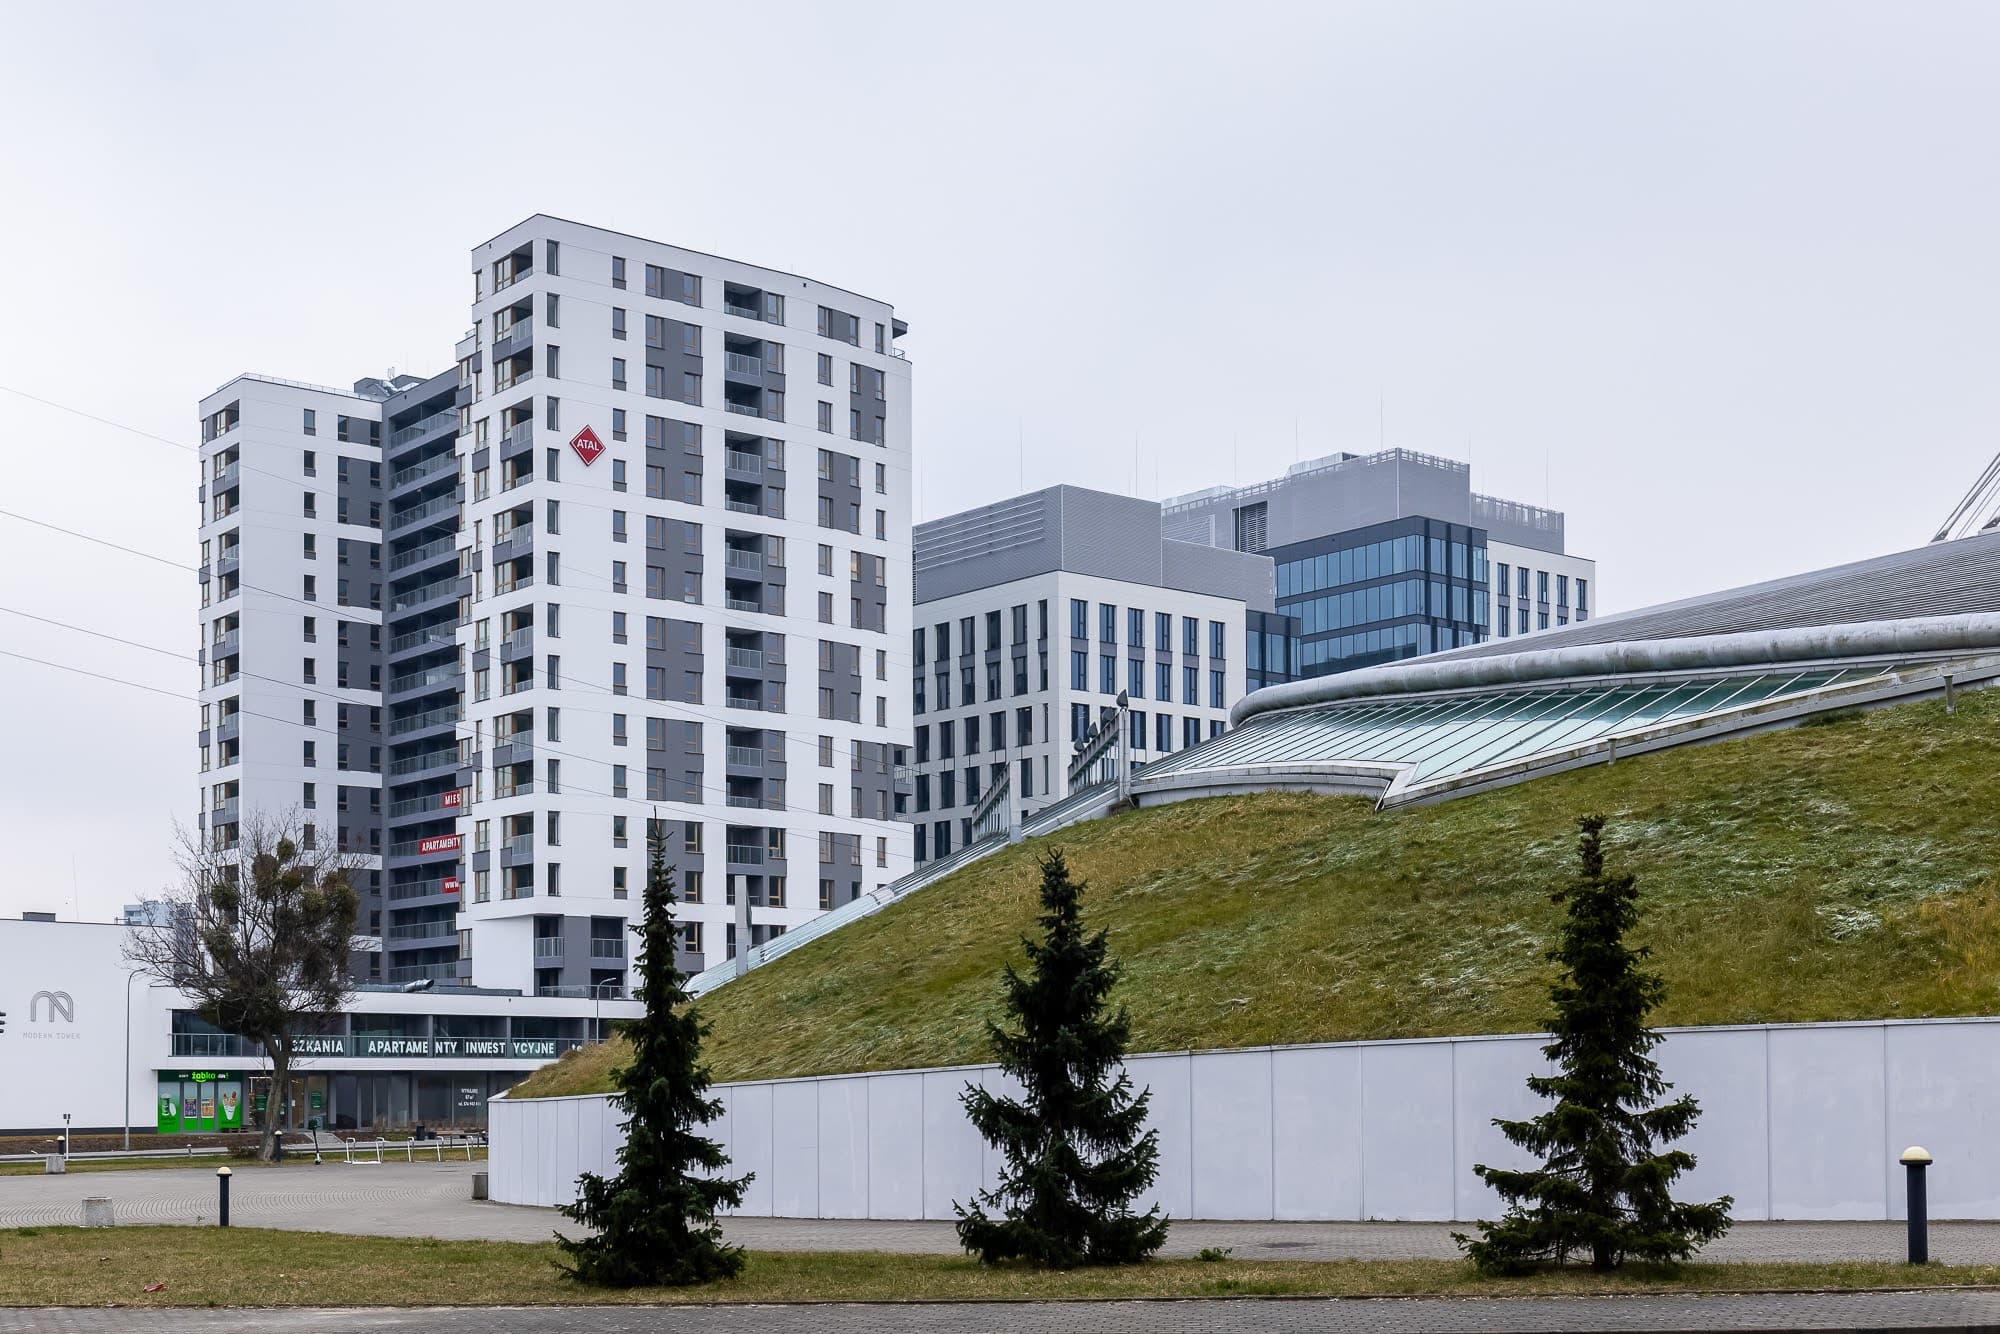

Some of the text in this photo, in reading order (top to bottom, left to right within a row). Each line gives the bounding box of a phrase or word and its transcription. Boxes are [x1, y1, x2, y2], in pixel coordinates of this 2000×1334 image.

[577, 438, 599, 451] ATAL
[422, 837, 460, 852] APARTAMENTY
[23, 1032, 81, 1040] MODERN TOWER
